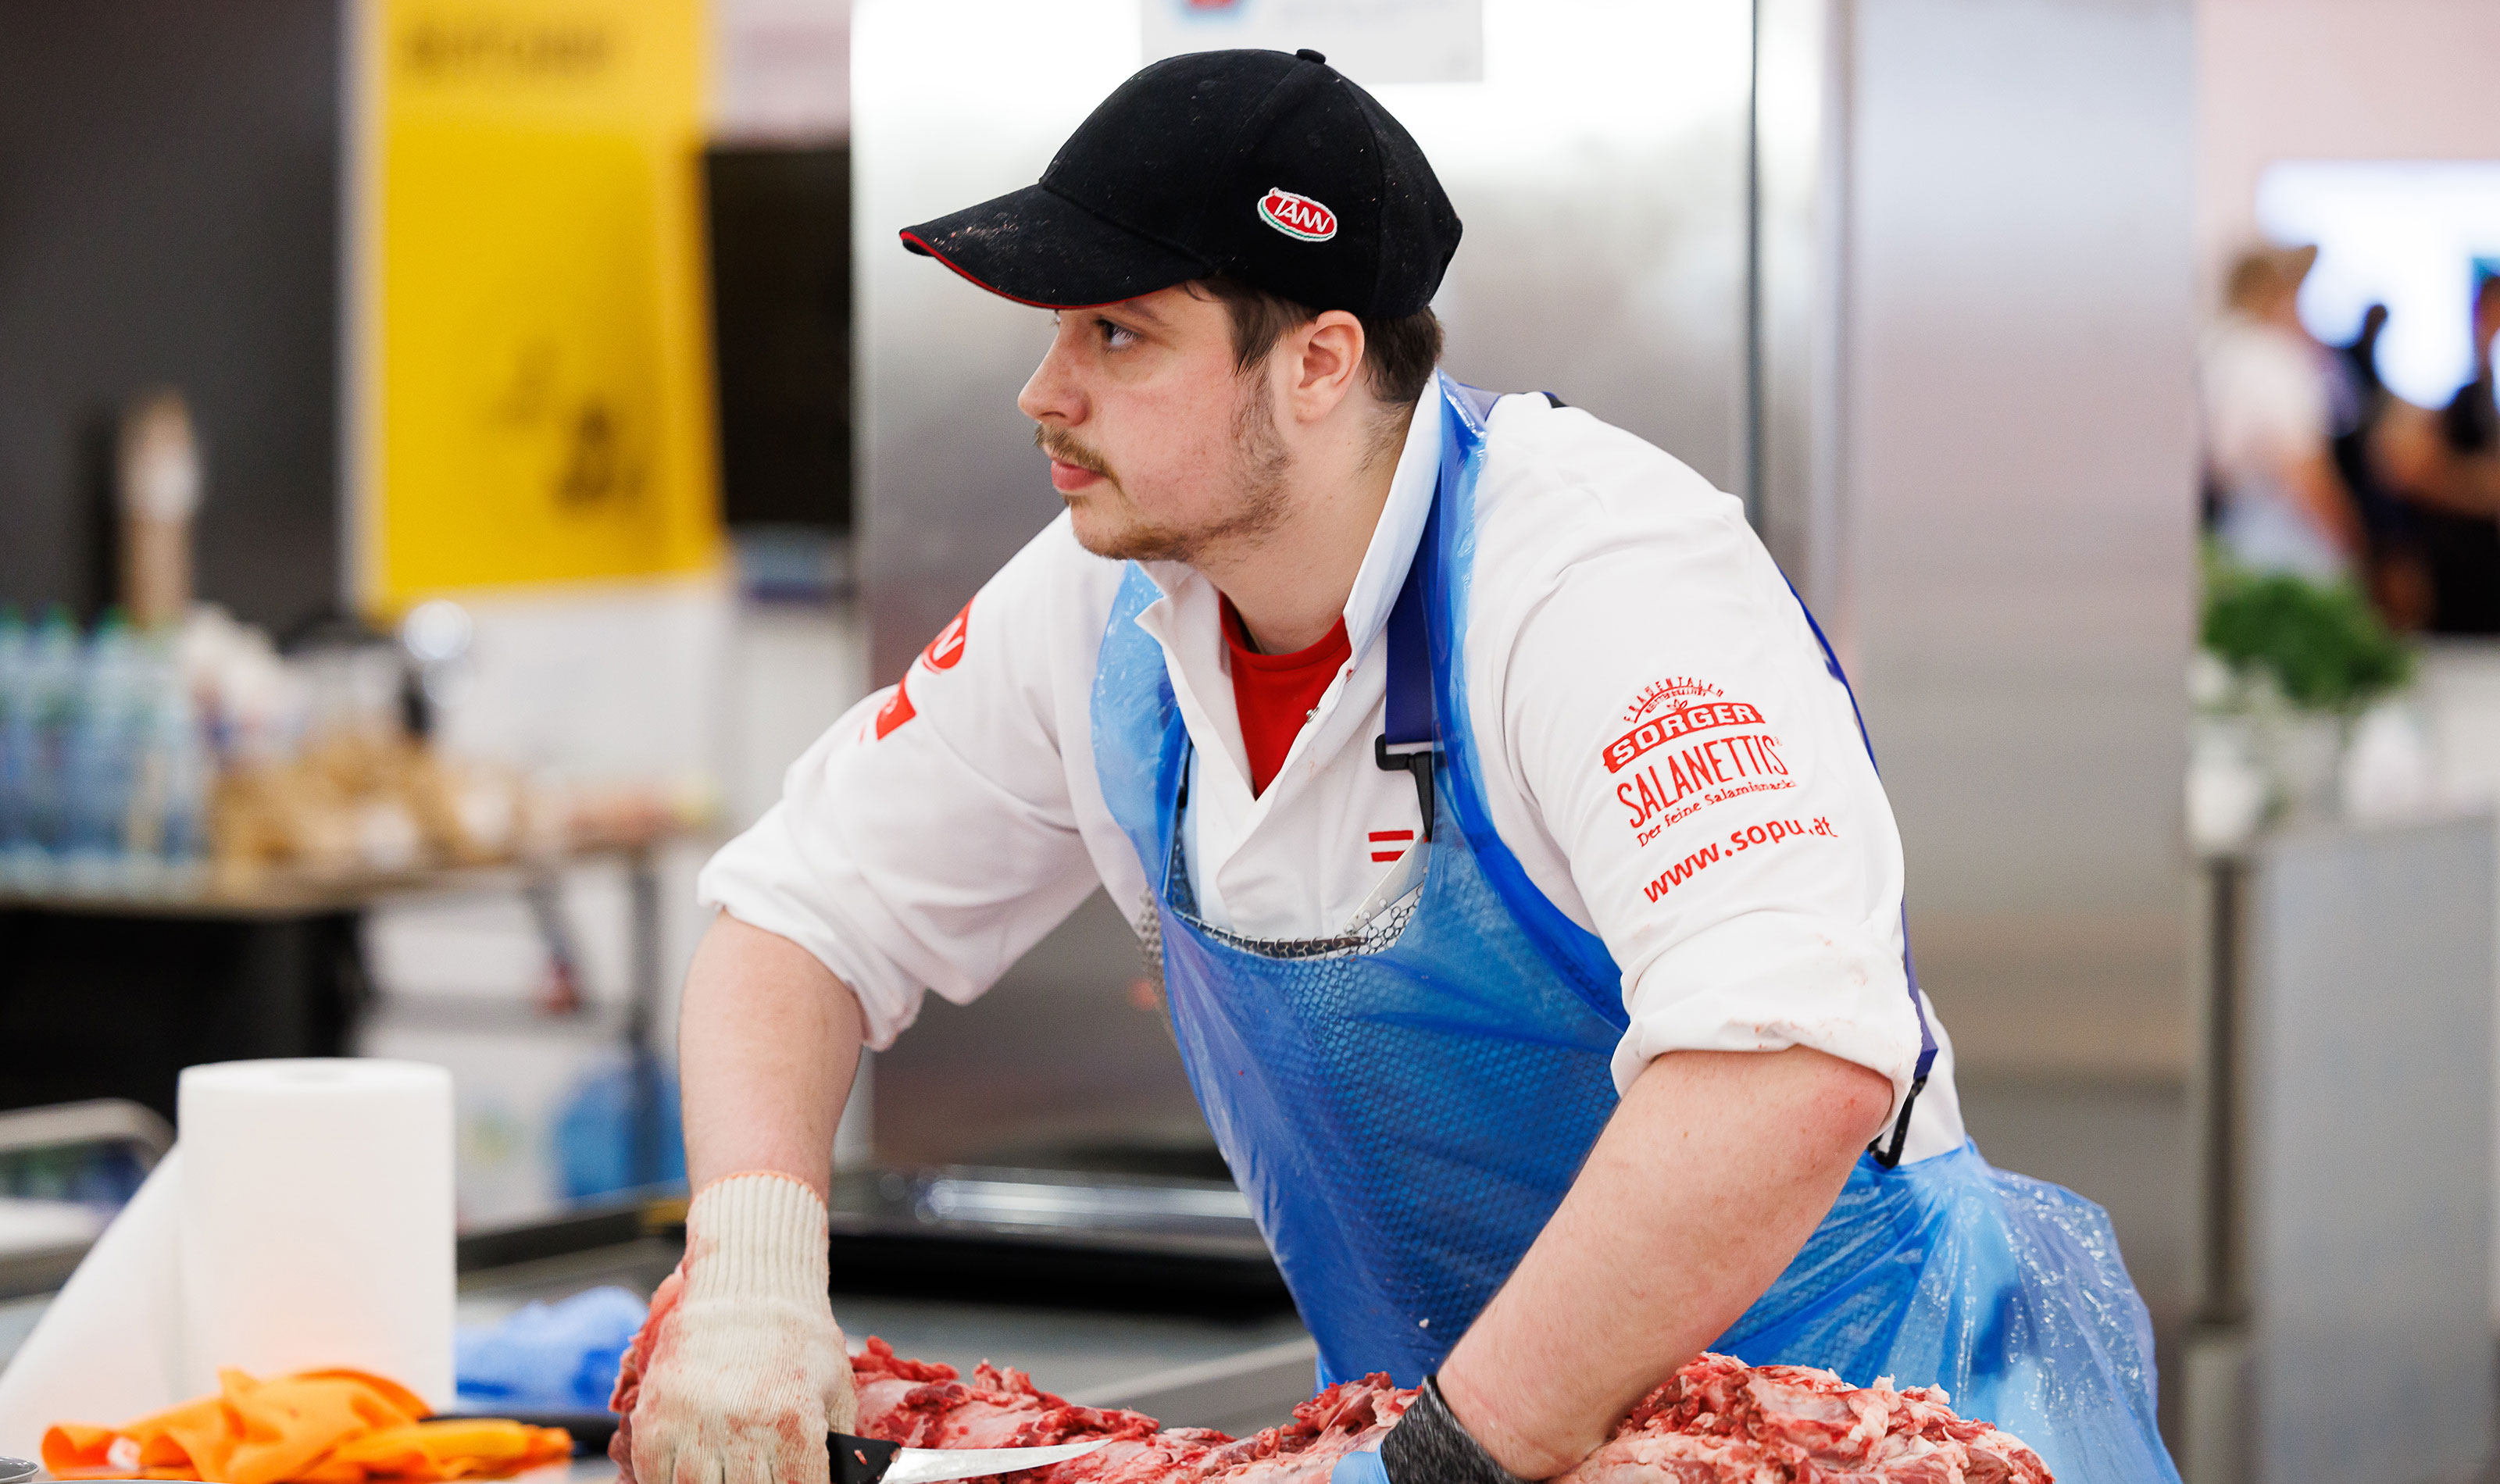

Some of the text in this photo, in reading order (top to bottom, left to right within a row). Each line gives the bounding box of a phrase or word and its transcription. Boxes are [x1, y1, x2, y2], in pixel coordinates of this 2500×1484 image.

[1273, 195, 1331, 233] TANN
[1612, 705, 1757, 765] SORGER
[1616, 735, 1789, 829] SALANETTIS
[1636, 824, 1662, 847] Der
[1664, 801, 1702, 827] feine
[1644, 816, 1838, 904] www.sopu.at
